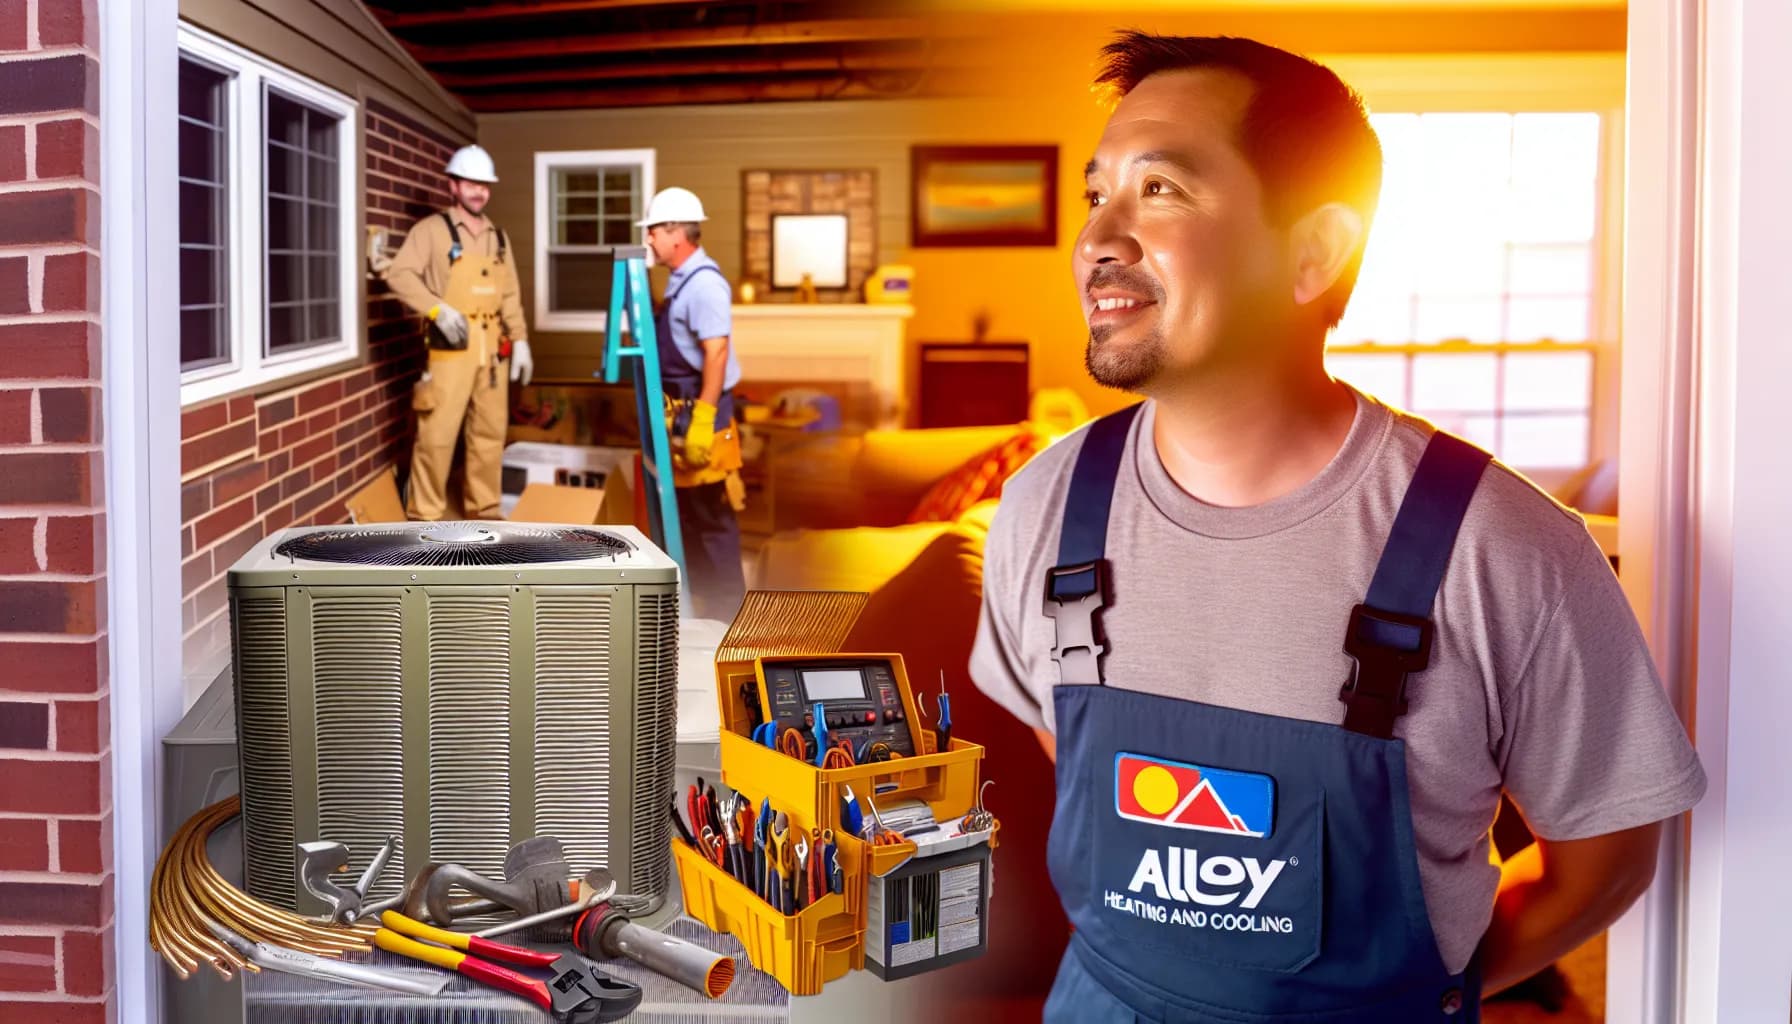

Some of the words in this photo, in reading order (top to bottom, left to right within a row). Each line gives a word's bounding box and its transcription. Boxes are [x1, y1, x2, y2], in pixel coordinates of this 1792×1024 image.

[1104, 890, 1167, 923] HEATING
[1170, 908, 1207, 928] AND
[1210, 913, 1293, 934] COOLING
